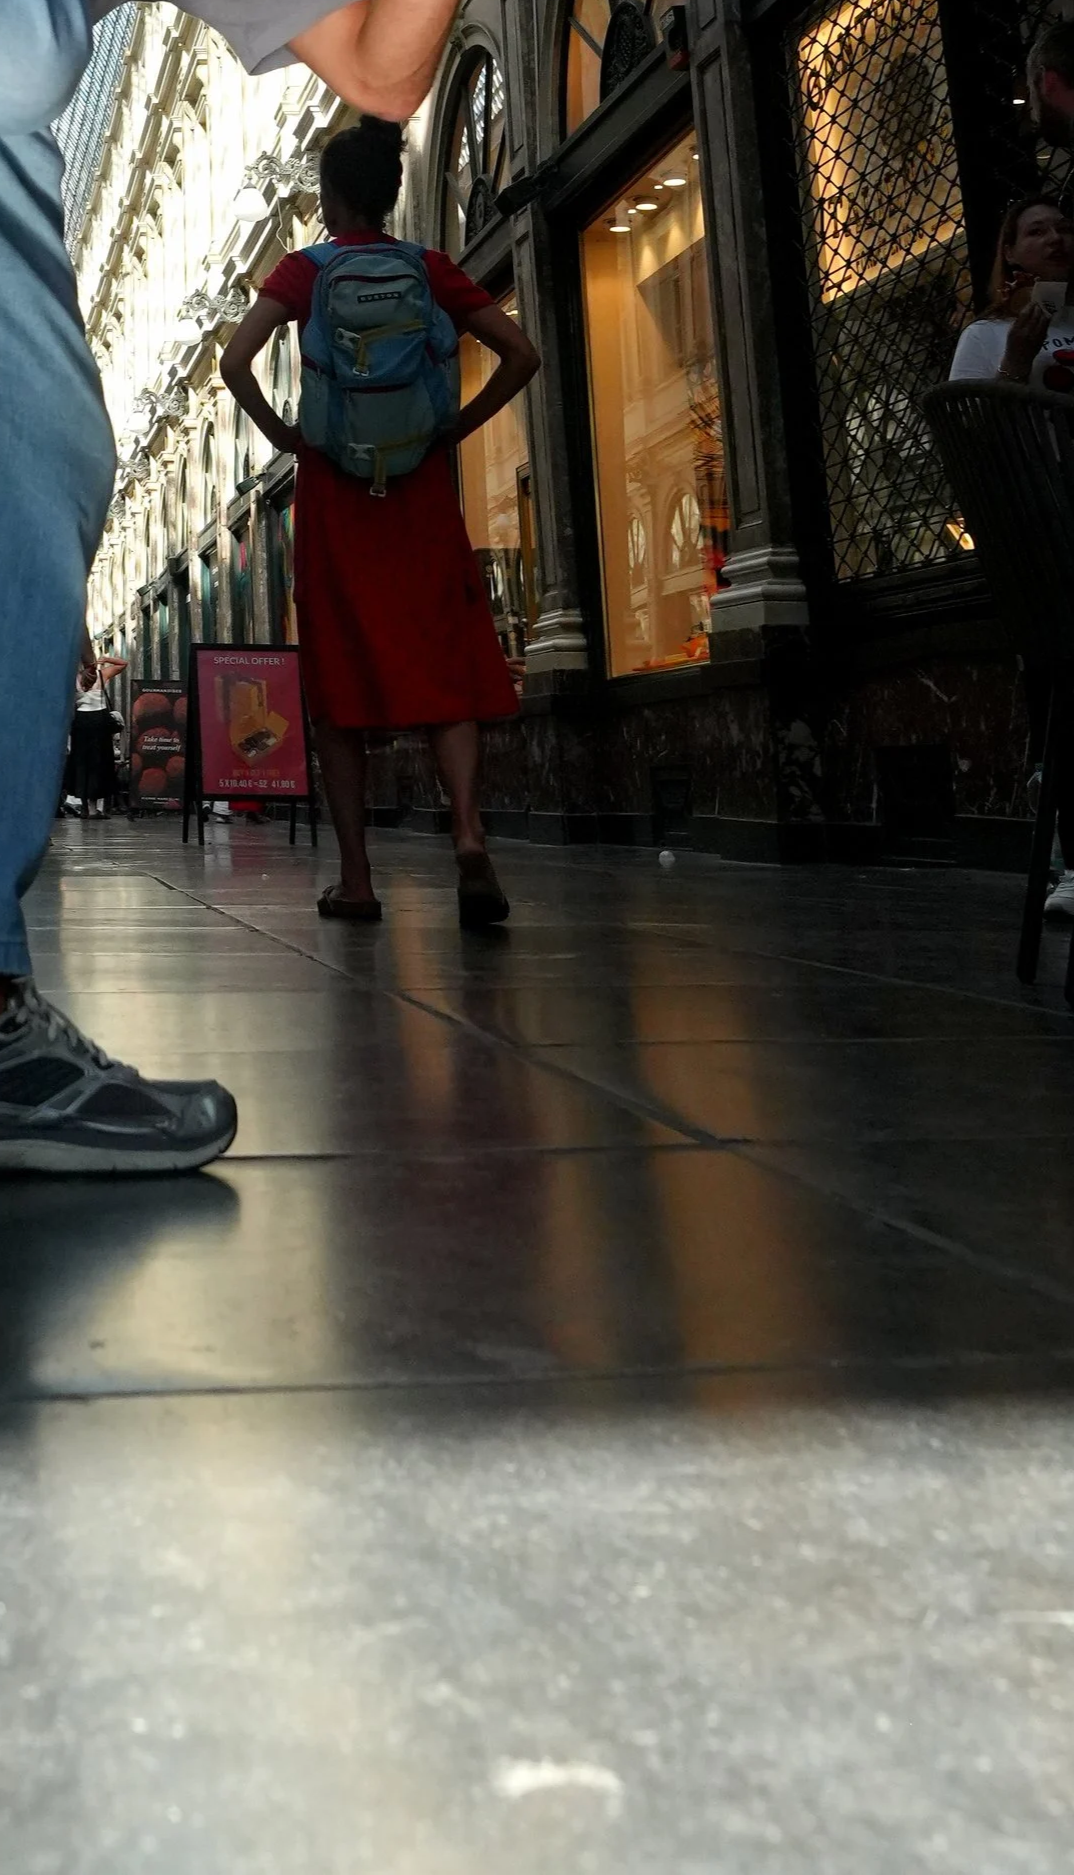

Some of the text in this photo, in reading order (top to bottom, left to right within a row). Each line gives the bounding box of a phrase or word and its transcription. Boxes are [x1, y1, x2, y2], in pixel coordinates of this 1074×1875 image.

[360, 292, 399, 302] BURTON
[213, 656, 250, 665] SPECIAL
[251, 657, 280, 665] OFFER
[157, 744, 182, 753] yourself
